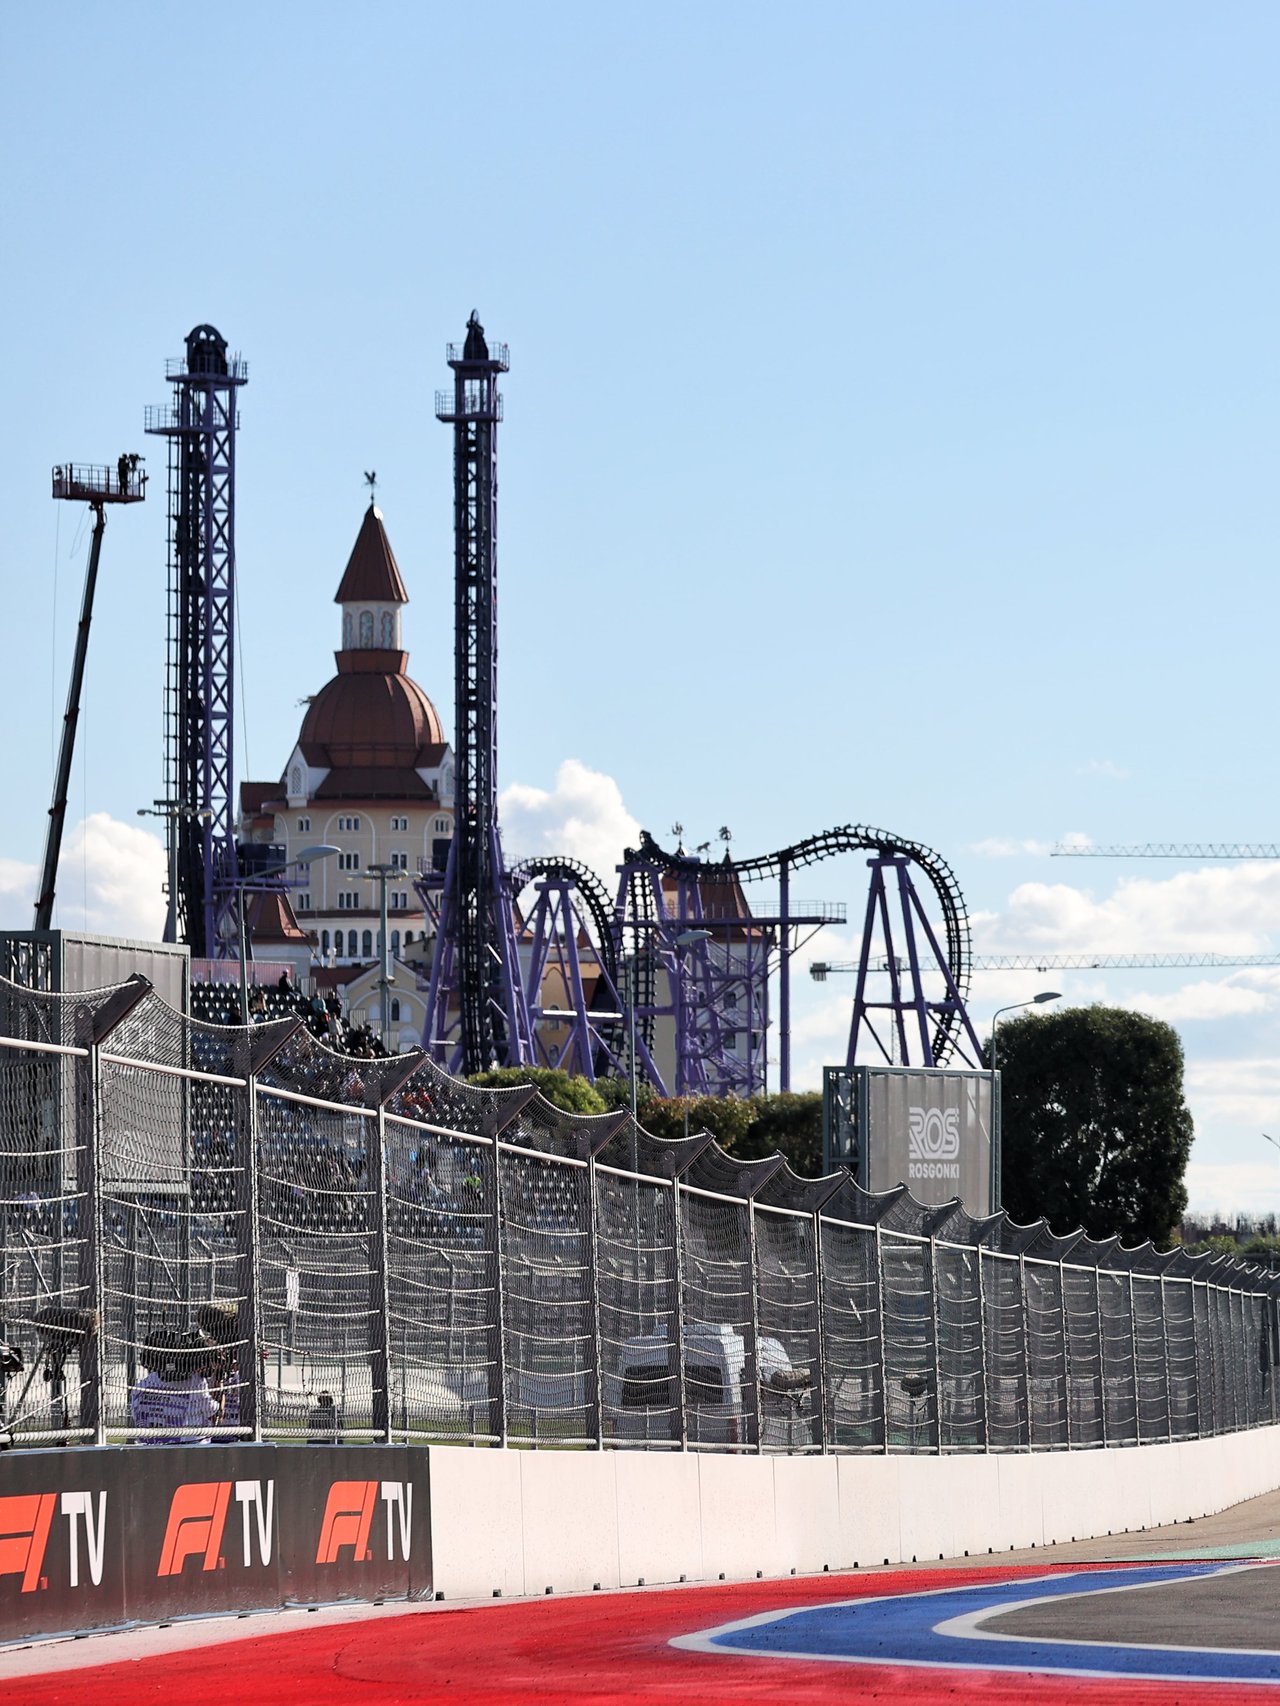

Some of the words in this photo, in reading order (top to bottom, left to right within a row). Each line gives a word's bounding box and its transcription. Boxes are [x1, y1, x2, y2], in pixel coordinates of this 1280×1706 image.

[908, 1163, 960, 1179] ROSGONKI
[909, 1106, 960, 1160] ROS
[61, 1491, 107, 1587] TV
[235, 1480, 274, 1567] TV
[381, 1481, 412, 1562] TV
